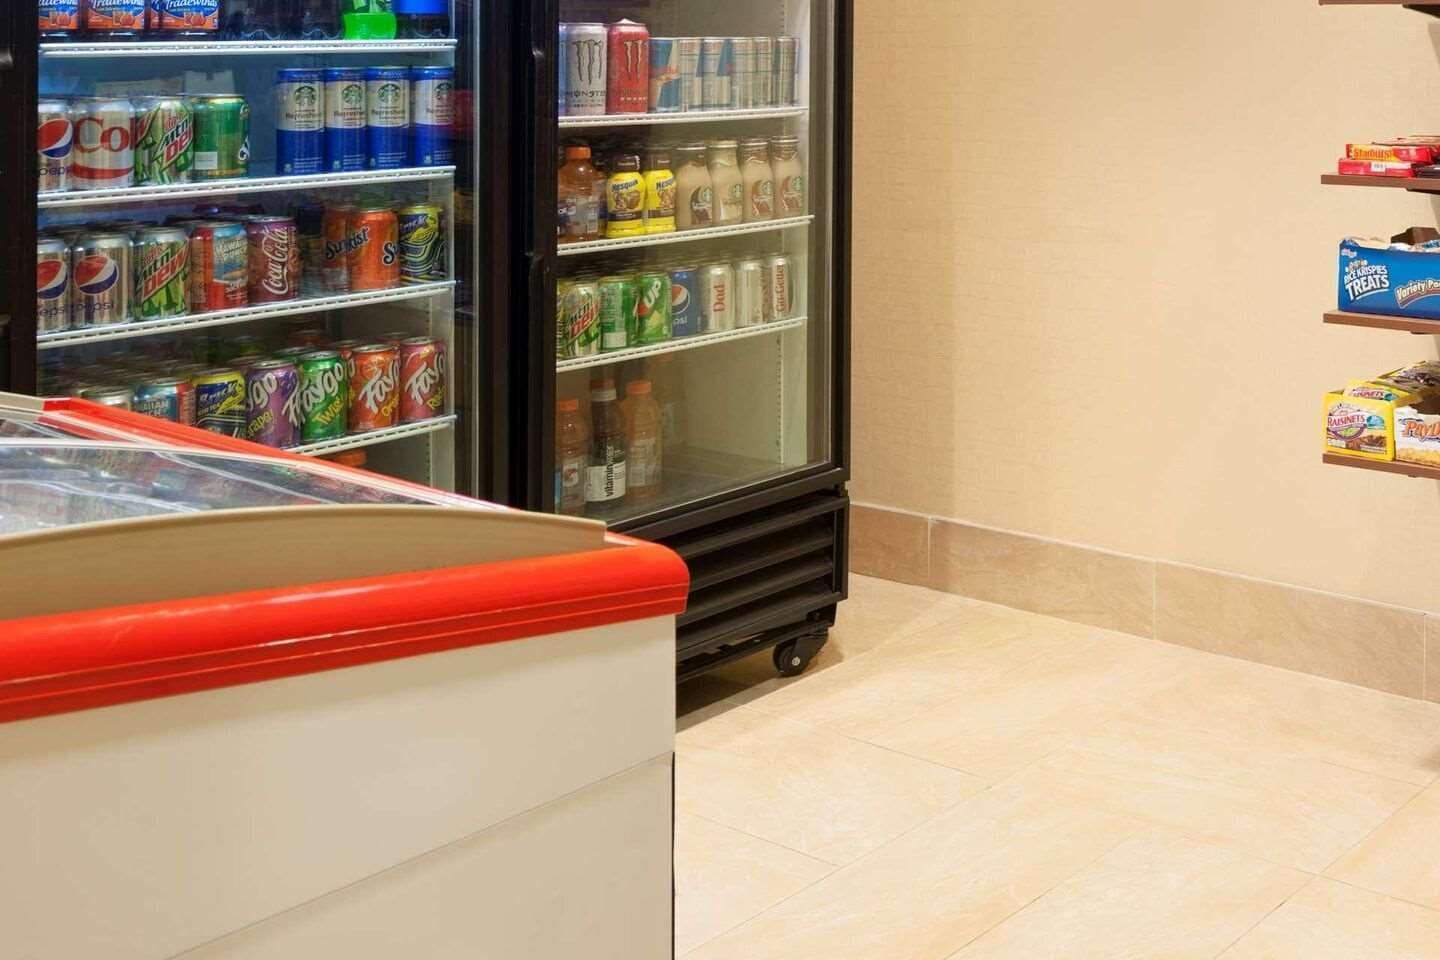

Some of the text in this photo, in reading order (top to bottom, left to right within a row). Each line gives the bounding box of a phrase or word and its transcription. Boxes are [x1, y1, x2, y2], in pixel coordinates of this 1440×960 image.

[1345, 275, 1390, 301] TREATS
[1396, 280, 1427, 301] Variety
[1327, 414, 1367, 429] RAISINETS
